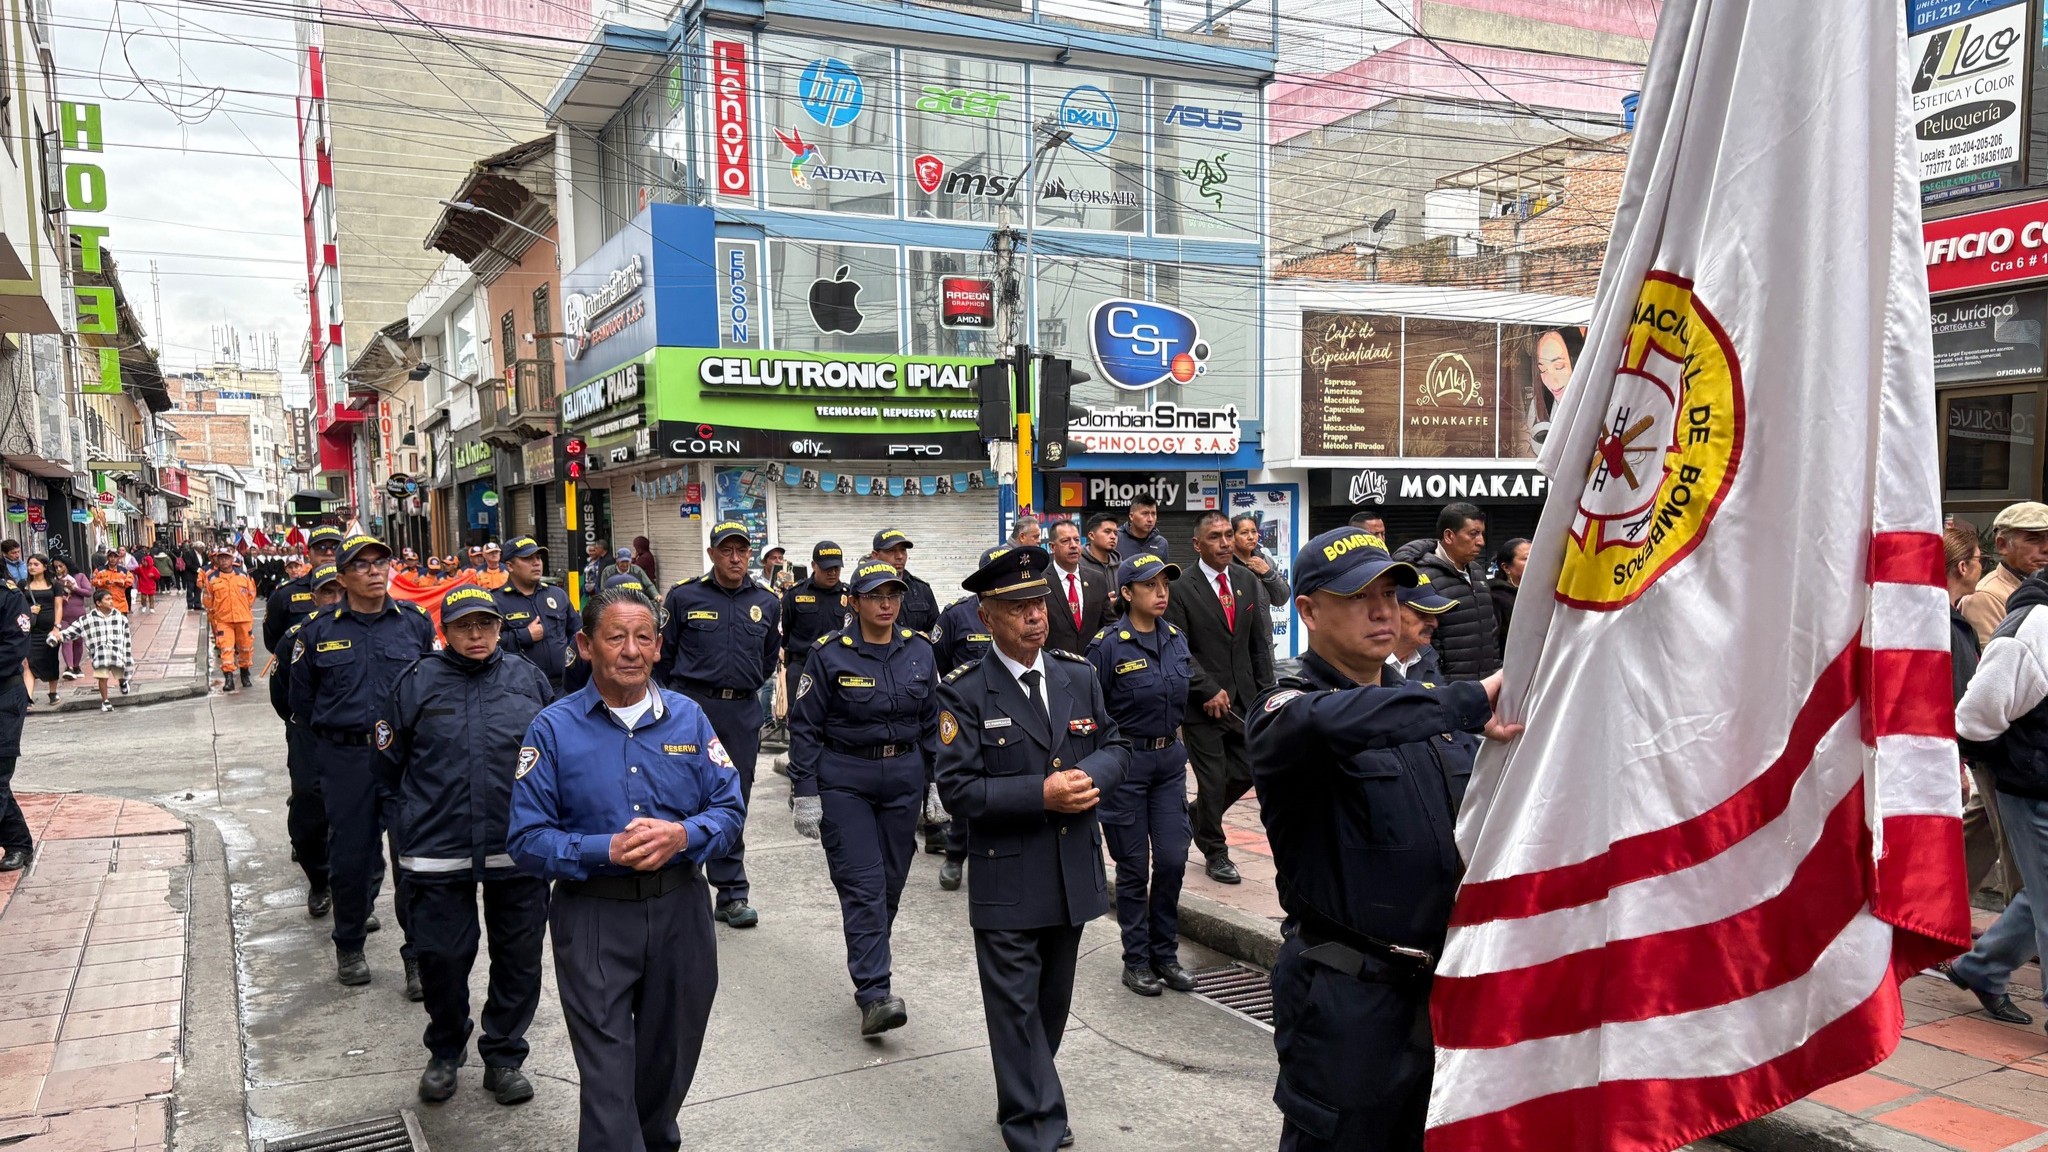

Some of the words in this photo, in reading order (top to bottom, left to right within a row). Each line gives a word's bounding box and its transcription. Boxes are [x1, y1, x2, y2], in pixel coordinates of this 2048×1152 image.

[1917, 3, 1961, 26] OFI.212
[916, 86, 1010, 118] acer
[1913, 88, 1963, 112] ESTETICA
[1964, 86, 1972, 98] Y
[1974, 75, 2015, 95] COLOR
[720, 46, 745, 190] Lenovo
[1066, 108, 1113, 129] DELL
[1164, 105, 1243, 132] ASUS
[1924, 103, 2001, 137] Peluquería
[1920, 149, 1946, 163] Locales
[1949, 134, 2003, 157] 203-204-205-206
[1925, 162, 1952, 176] 7737772
[1955, 156, 1969, 168] Cel:
[1972, 147, 2013, 166] 3184361020
[811, 165, 887, 185] ADATA
[944, 172, 1018, 199] msi
[1069, 189, 1139, 208] CORSAIR
[1925, 227, 2015, 266] IFICIO
[1991, 261, 2013, 272] Cra
[2017, 257, 2024, 268] 6
[2029, 254, 2037, 266] #
[730, 250, 749, 343] EPSON
[946, 291, 990, 301] RADEON
[952, 300, 985, 308] GRAPHICS
[956, 315, 974, 324] AMD
[1952, 303, 2014, 322] Jurídica
[1107, 306, 1179, 367] CST
[1325, 320, 1357, 348] Café
[1358, 324, 1376, 338] de
[1940, 322, 1967, 333] ORTEGA
[1311, 343, 1393, 372] Especialidad
[700, 357, 898, 390] CELUTRONIC
[906, 363, 978, 389] IPIAL
[1996, 368, 2026, 376] OFICINA
[2027, 366, 2041, 374] 410
[1324, 378, 1356, 387] Espresso
[1324, 387, 1363, 396] Americano
[1324, 396, 1360, 404] Macchiato
[816, 406, 879, 418] TECNOLOGIA
[883, 407, 937, 419] REPUESTOS
[940, 408, 948, 419] Y
[1324, 405, 1365, 415] Capucchino
[1324, 414, 1341, 423] Latte
[1324, 423, 1365, 432] Mocacchino
[1409, 416, 1490, 427] MONAKAFFE
[1688, 405, 1711, 445] DE
[1069, 436, 1186, 453] ECHNOLOGY
[1323, 432, 1348, 442] Frappe
[1323, 441, 1353, 450] Métodos
[1354, 441, 1385, 450] Filtrados
[671, 440, 741, 454] CORN
[1090, 477, 1180, 506] Phonify
[1400, 474, 1548, 499] MONAKAF
[1613, 463, 1702, 586] BOMBEROS
[663, 744, 697, 754] RESERVA
